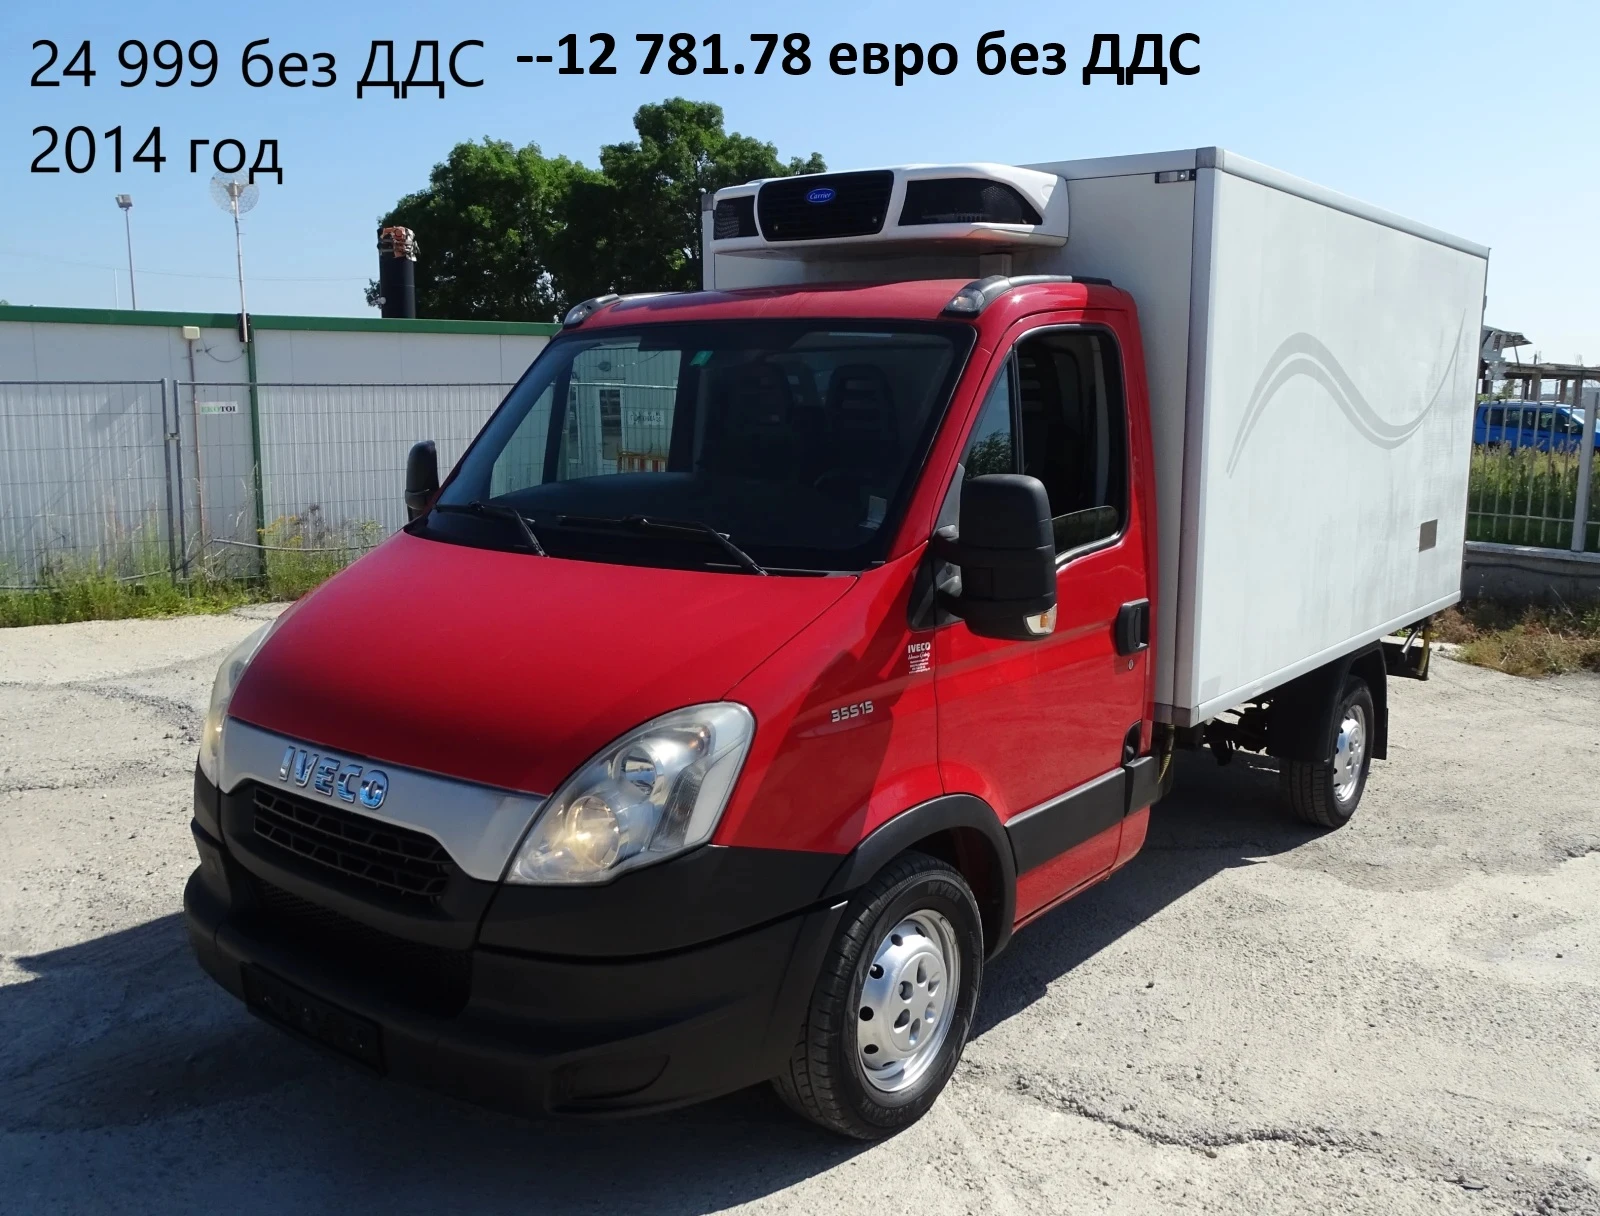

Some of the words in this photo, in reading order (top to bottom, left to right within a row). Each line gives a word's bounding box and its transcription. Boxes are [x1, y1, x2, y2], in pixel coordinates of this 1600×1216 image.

[809, 191, 832, 200] Carrier
[907, 641, 931, 653] IVECO
[831, 700, 874, 723] 35S15
[278, 745, 389, 810] IVECO
